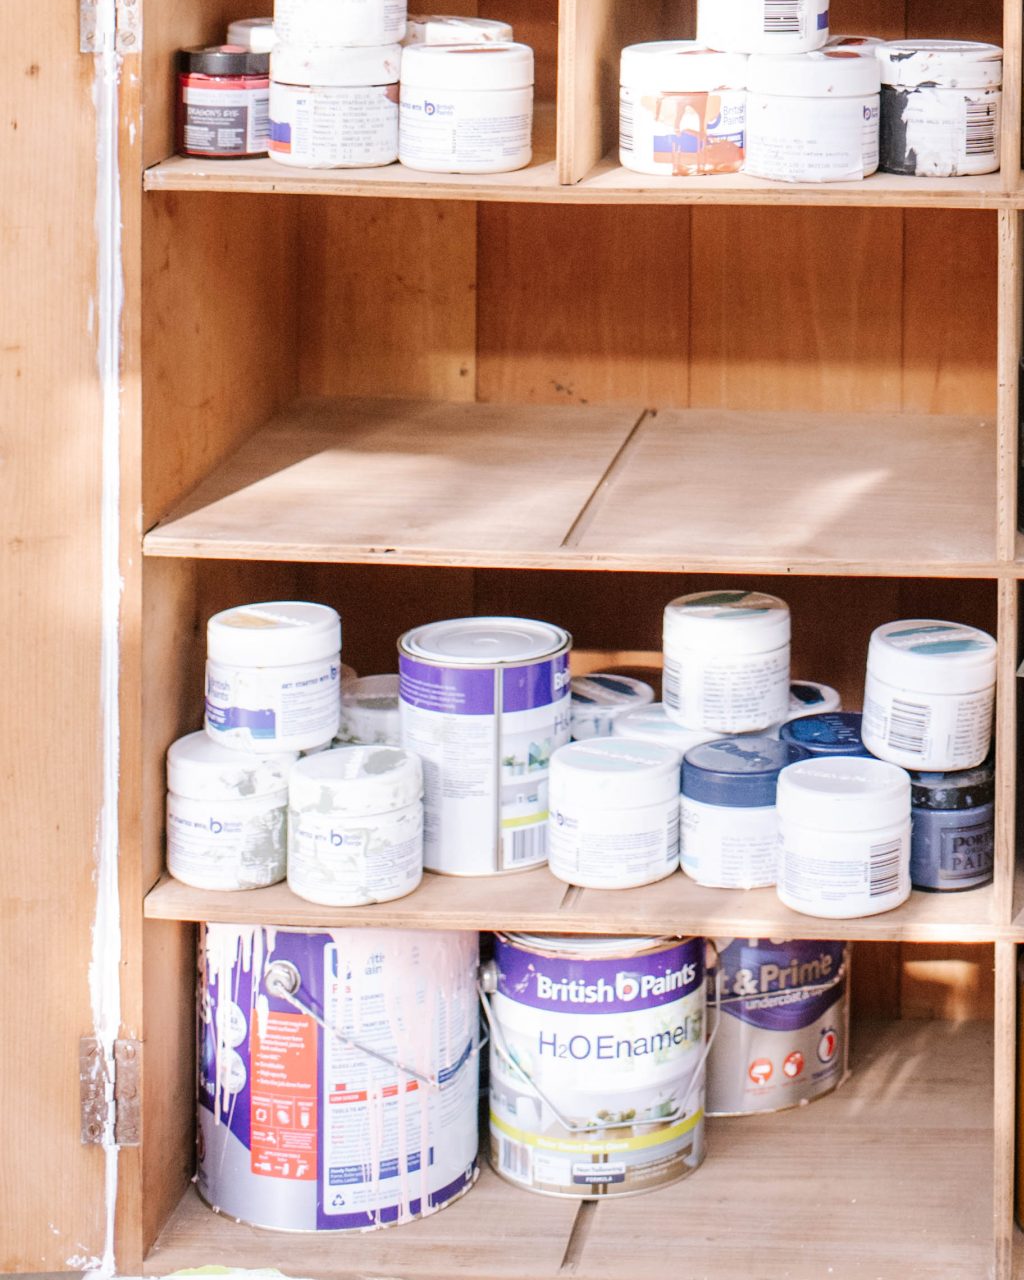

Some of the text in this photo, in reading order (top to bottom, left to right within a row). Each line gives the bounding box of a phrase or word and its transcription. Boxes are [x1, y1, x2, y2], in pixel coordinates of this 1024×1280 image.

[537, 974, 614, 1002] British
[640, 963, 696, 997] Paints
[733, 954, 832, 996] & Prime
